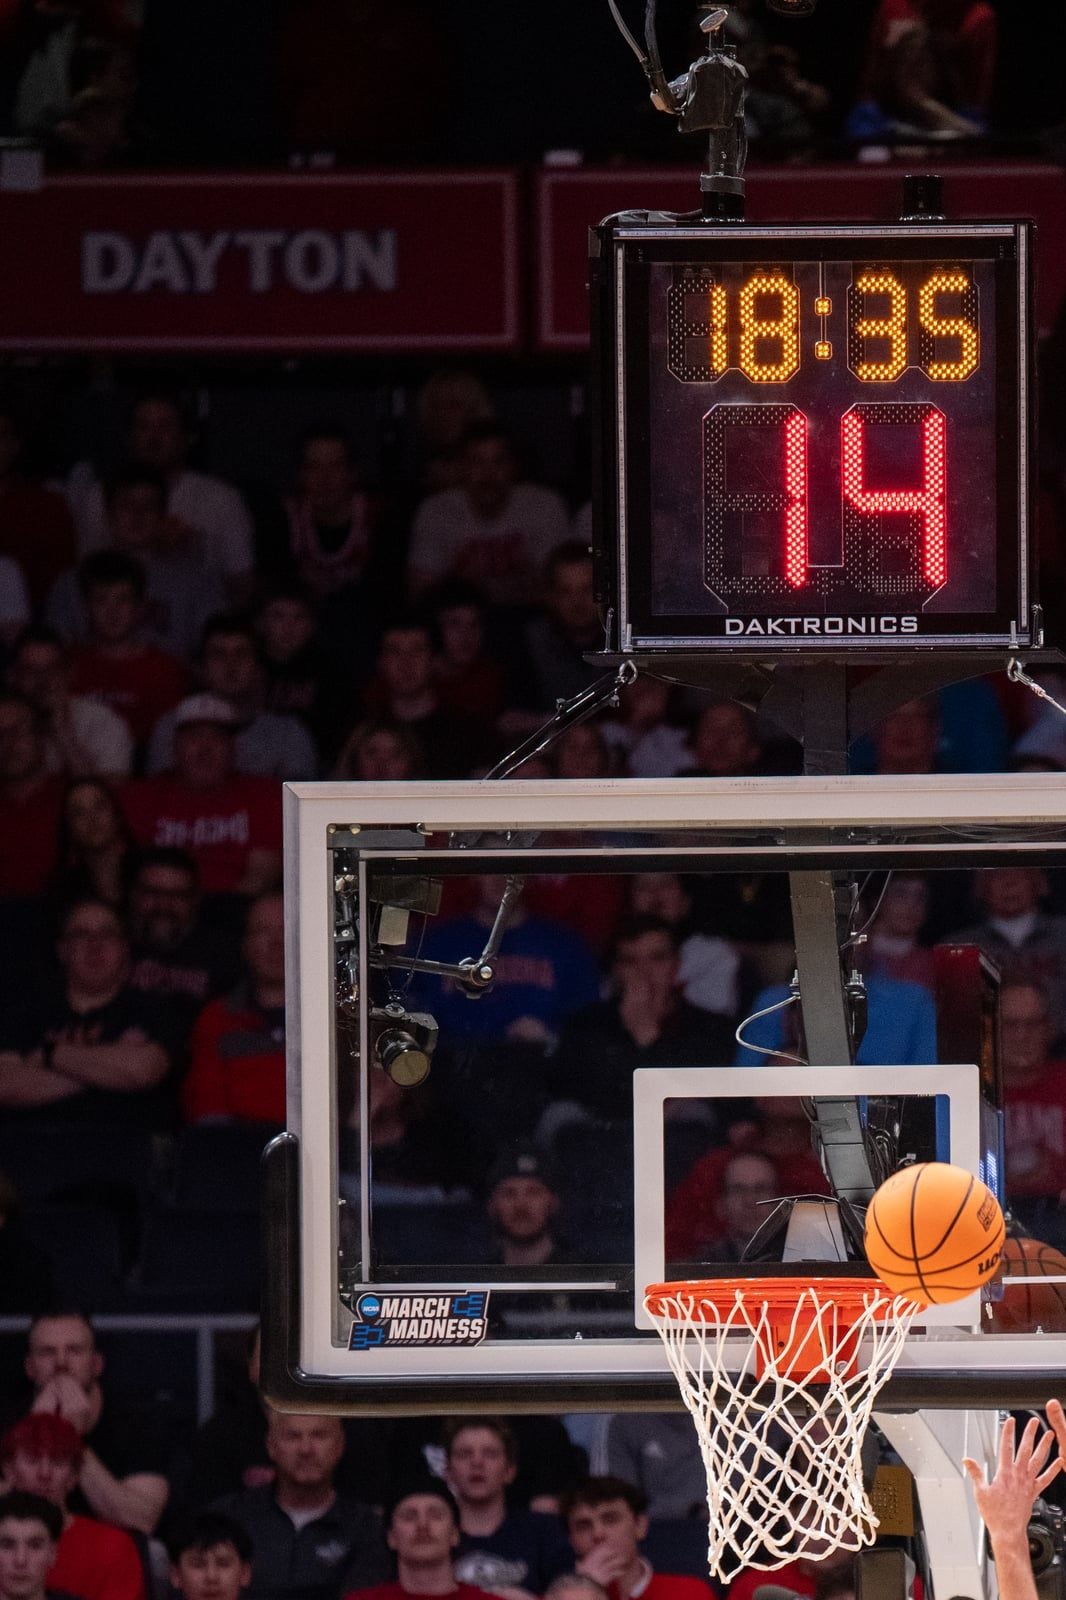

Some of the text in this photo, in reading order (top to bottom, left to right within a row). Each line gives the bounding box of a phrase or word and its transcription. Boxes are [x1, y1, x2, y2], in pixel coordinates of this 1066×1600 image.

[80, 228, 399, 296] DAYTON
[710, 275, 980, 382] 18:35
[785, 411, 946, 588] 14
[725, 616, 918, 635] DAKTRONICS
[380, 1298, 451, 1318] MARCH
[388, 1319, 483, 1339] MADNESS
